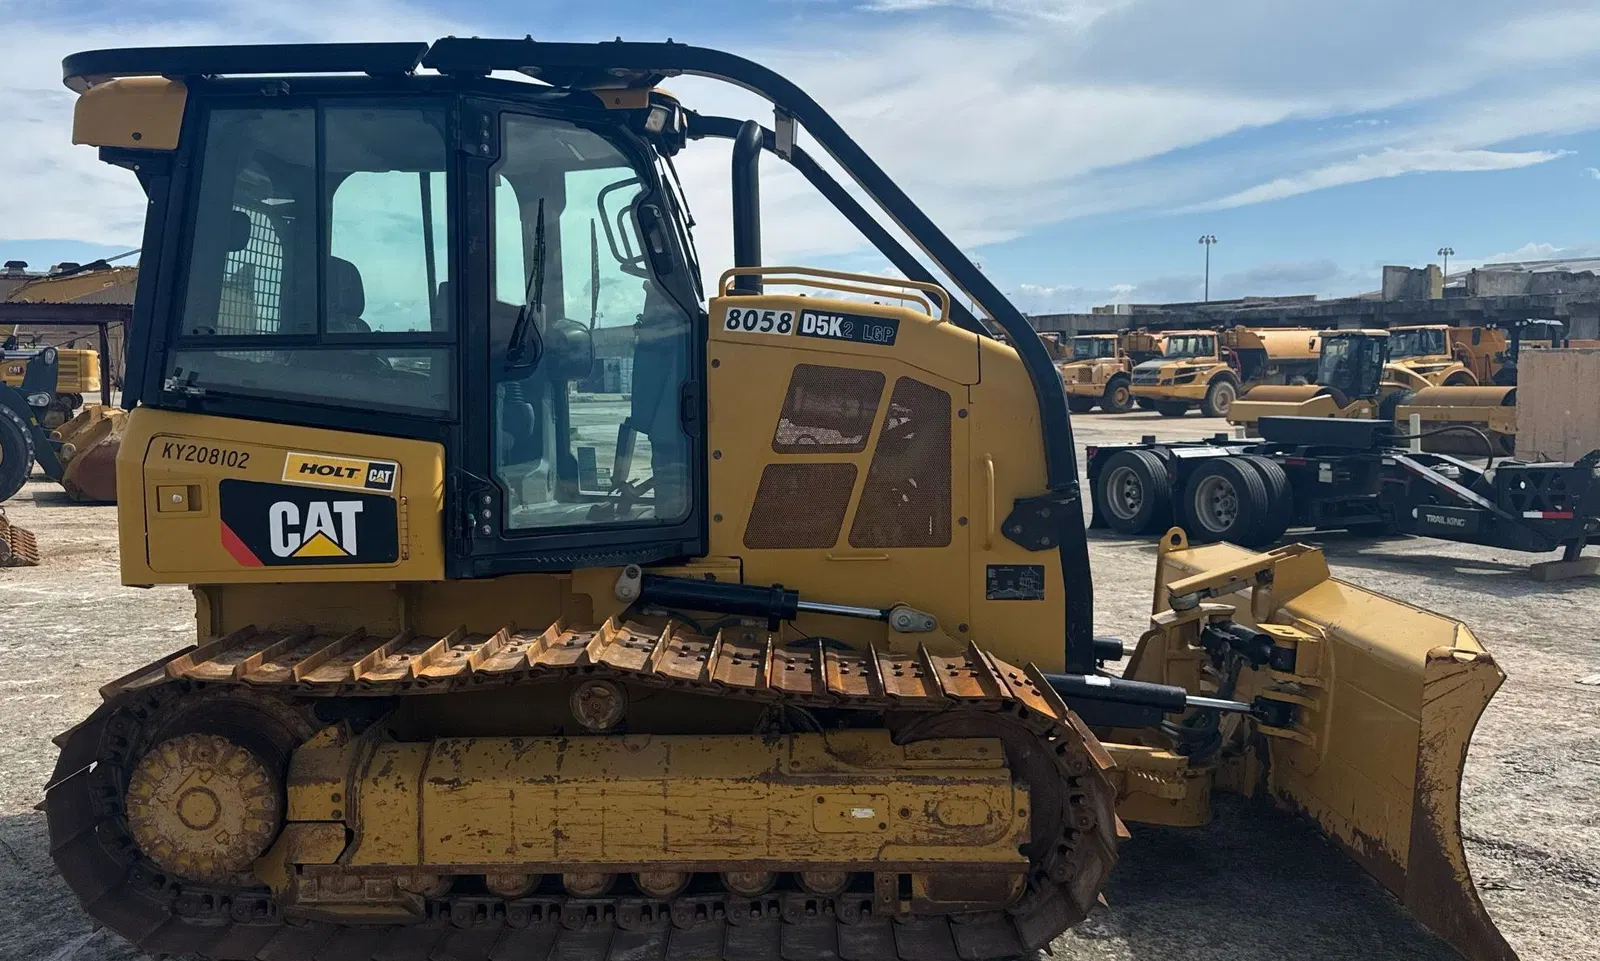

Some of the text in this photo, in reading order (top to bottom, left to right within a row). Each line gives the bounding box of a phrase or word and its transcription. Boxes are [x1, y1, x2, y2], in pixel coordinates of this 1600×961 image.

[726, 309, 793, 335] 8058
[863, 324, 895, 343] LGP
[162, 442, 250, 469] KY208102
[299, 463, 393, 484] HOLT CAT
[269, 501, 364, 558] CAT
[1426, 514, 1465, 527] TRAIL KING
